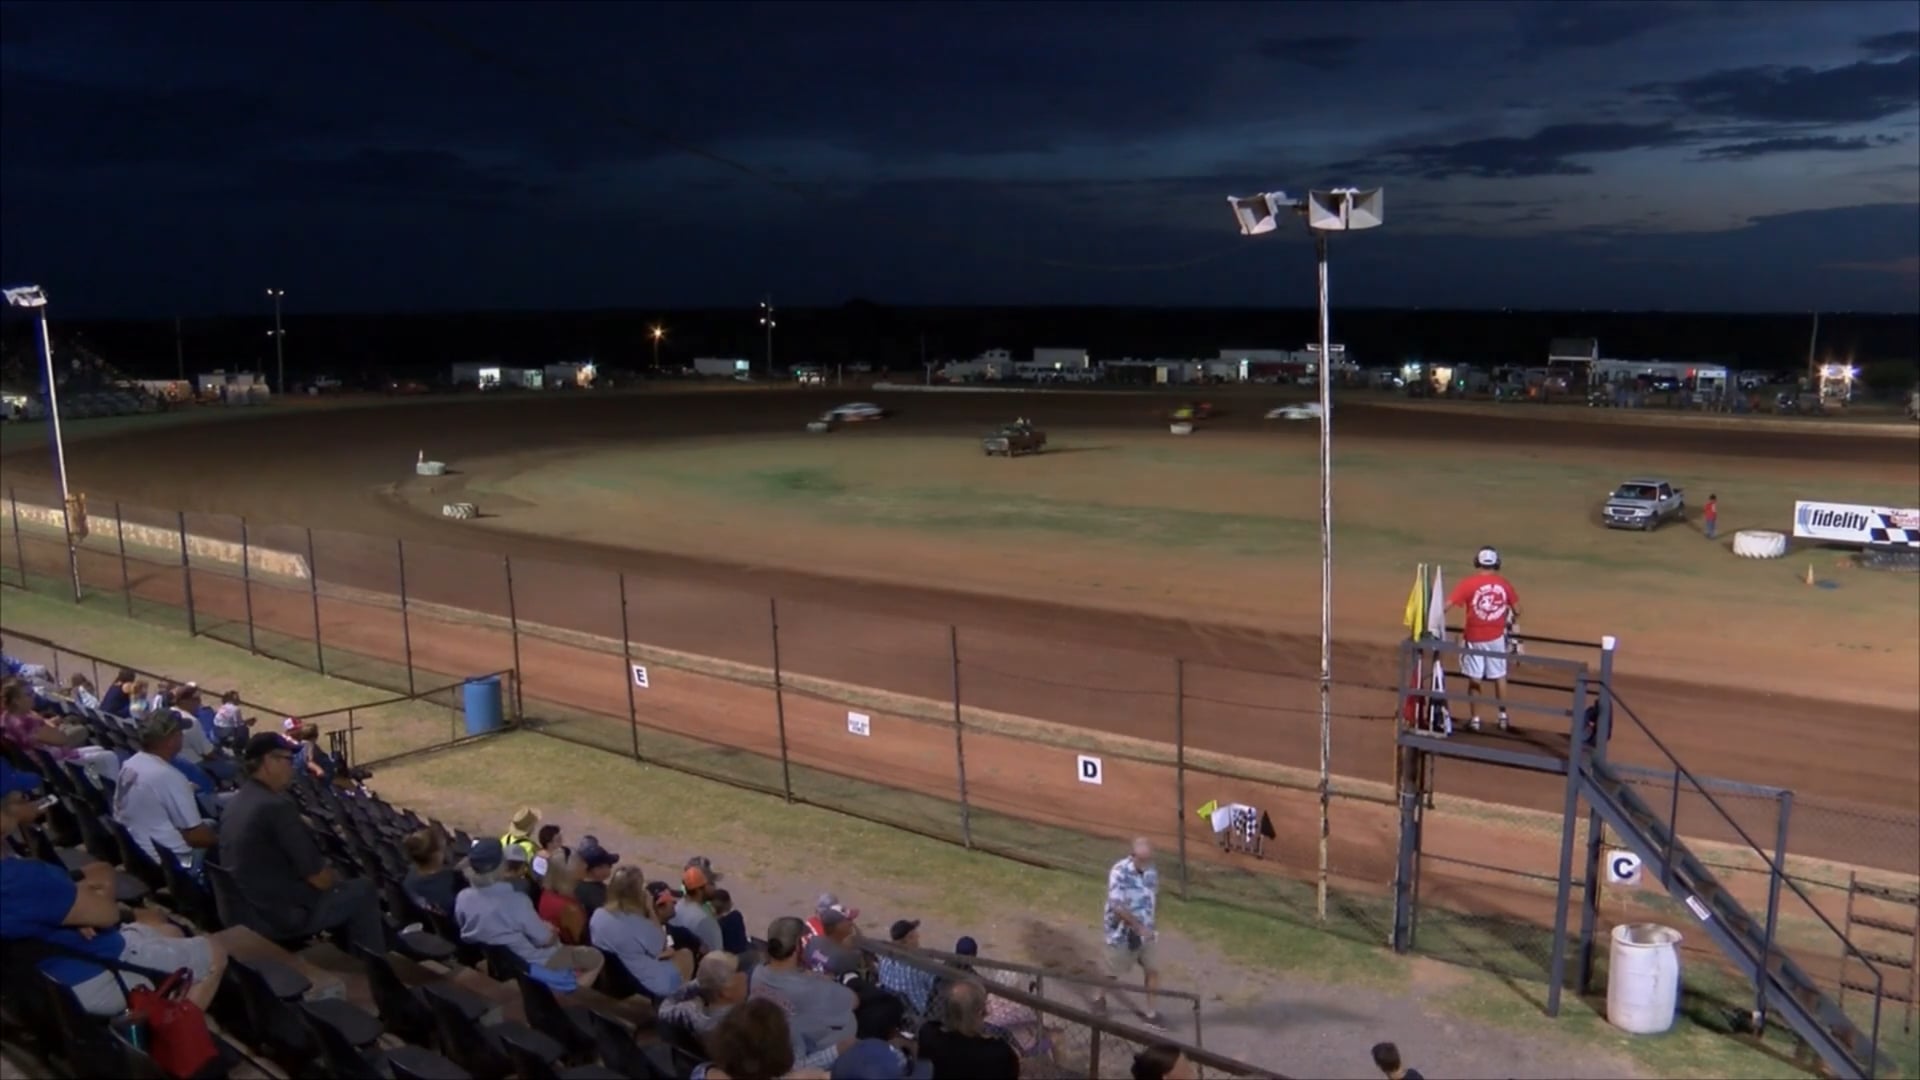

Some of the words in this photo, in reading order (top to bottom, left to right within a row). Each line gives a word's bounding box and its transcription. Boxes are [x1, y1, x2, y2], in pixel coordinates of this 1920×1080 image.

[1811, 509, 1869, 531] fidelity
[636, 669, 646, 684] E
[1083, 760, 1098, 778] D
[1613, 858, 1634, 879] C
